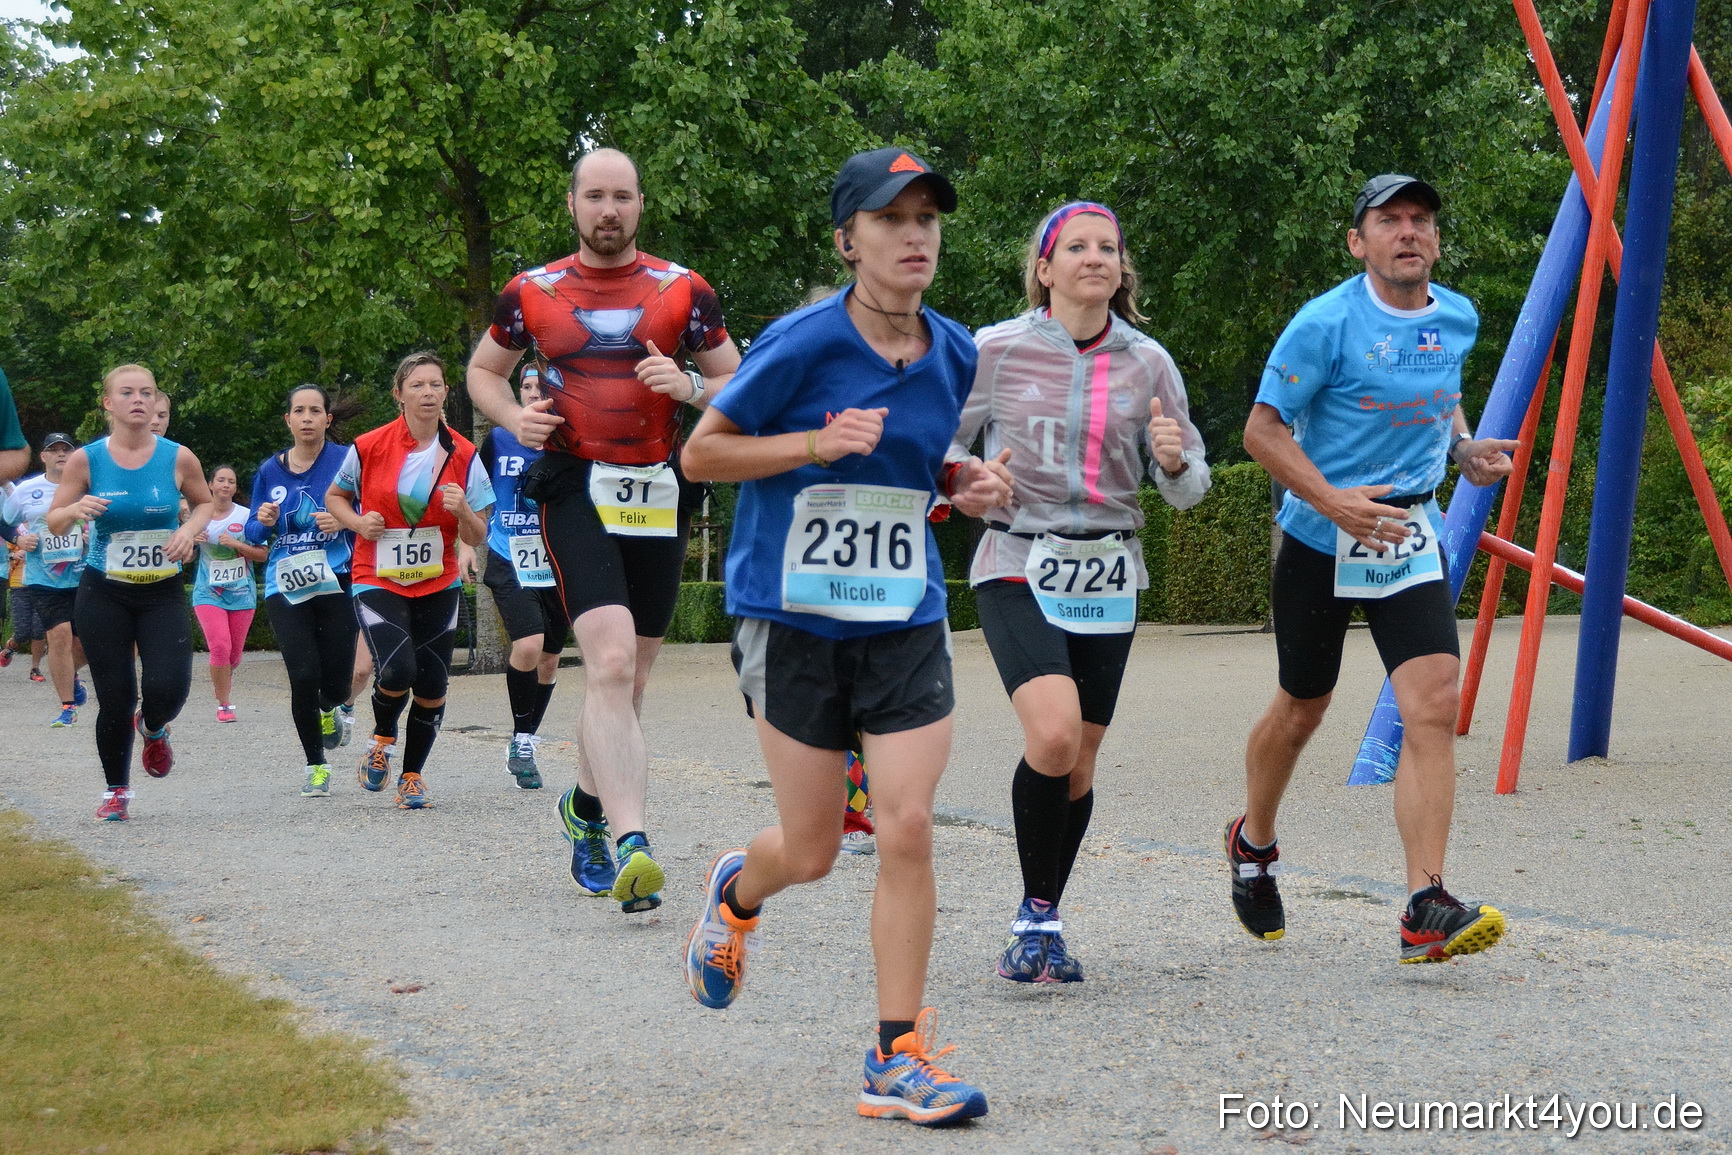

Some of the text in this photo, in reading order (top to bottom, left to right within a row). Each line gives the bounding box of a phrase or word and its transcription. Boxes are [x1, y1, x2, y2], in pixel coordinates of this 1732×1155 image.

[1028, 415, 1067, 474] T
[498, 456, 525, 477] 13
[271, 486, 288, 504] 9
[616, 477, 653, 504] 31
[855, 490, 915, 510] BOCK
[620, 511, 648, 525] Felix
[45, 534, 78, 551] 3087
[802, 518, 913, 571] 2316
[122, 544, 164, 568] 256
[392, 542, 432, 567] 156
[213, 566, 244, 582] 2470
[280, 563, 326, 592] 3037
[399, 570, 424, 580] Beate
[1038, 555, 1127, 593] 2724
[830, 581, 887, 602] Nicole
[1057, 602, 1104, 618] Sandra
